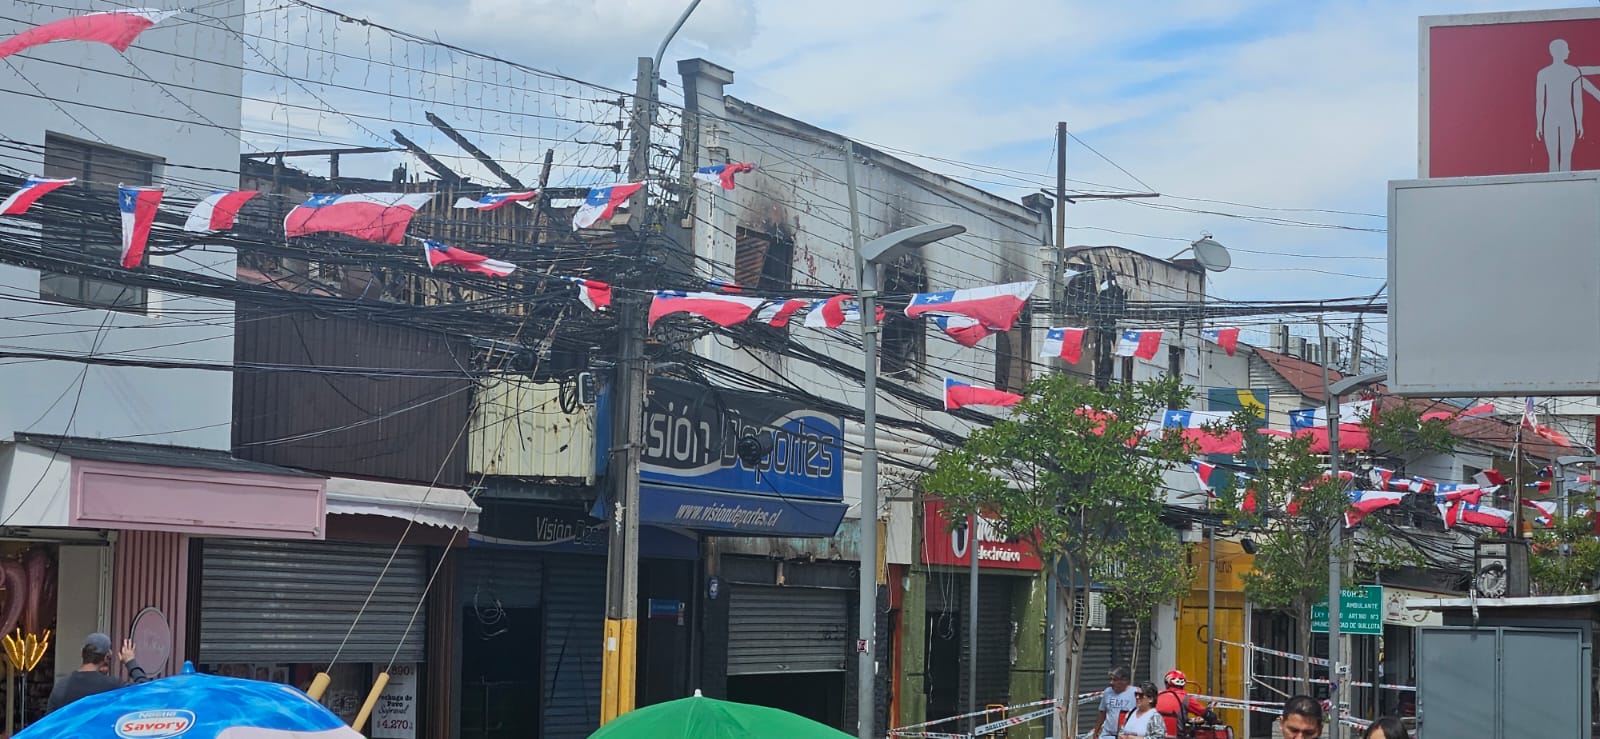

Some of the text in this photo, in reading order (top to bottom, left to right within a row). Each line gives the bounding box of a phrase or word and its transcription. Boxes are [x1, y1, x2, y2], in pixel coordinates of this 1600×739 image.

[675, 502, 783, 527] www.visiondeportes.cl
[536, 516, 573, 540] Visión
[1346, 602, 1379, 610] AMBULANTE
[122, 721, 187, 732] Savory
